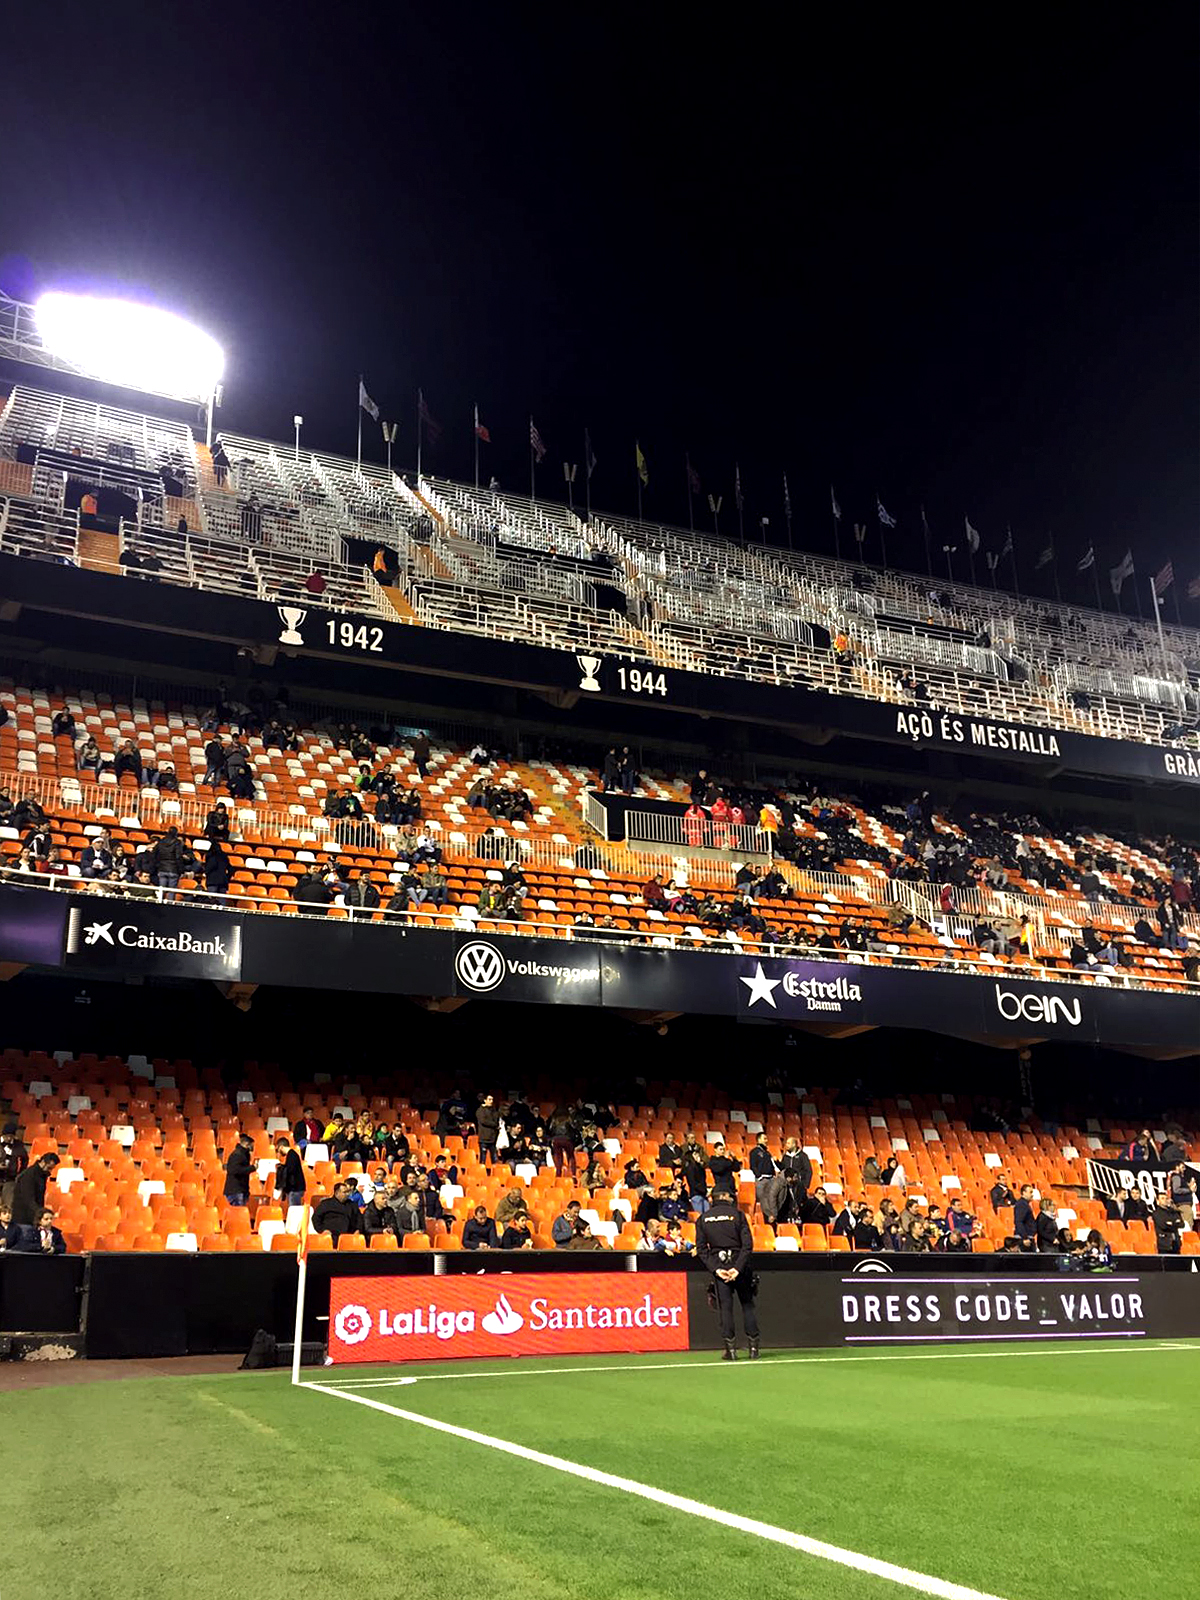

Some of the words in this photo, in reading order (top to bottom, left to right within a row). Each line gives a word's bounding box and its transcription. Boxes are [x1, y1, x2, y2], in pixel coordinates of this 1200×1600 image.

[326, 620, 384, 652] 1942
[617, 667, 668, 696] 1944
[896, 711, 933, 741] AÇÒ
[940, 714, 965, 742] ÉS
[970, 723, 1061, 757] MESTALLA
[1164, 752, 1200, 777] GRÀ
[117, 925, 226, 956] CaixaBank
[507, 959, 600, 982] Volkswagen
[783, 971, 862, 1001] Estrella
[806, 997, 842, 1012] Damm
[995, 983, 1082, 1026] beIN
[379, 1305, 475, 1339] LaLiga
[529, 1295, 683, 1331] Santander
[842, 1295, 941, 1322] DRESS
[955, 1294, 1031, 1321] CODE
[1060, 1293, 1144, 1320] VALOR
